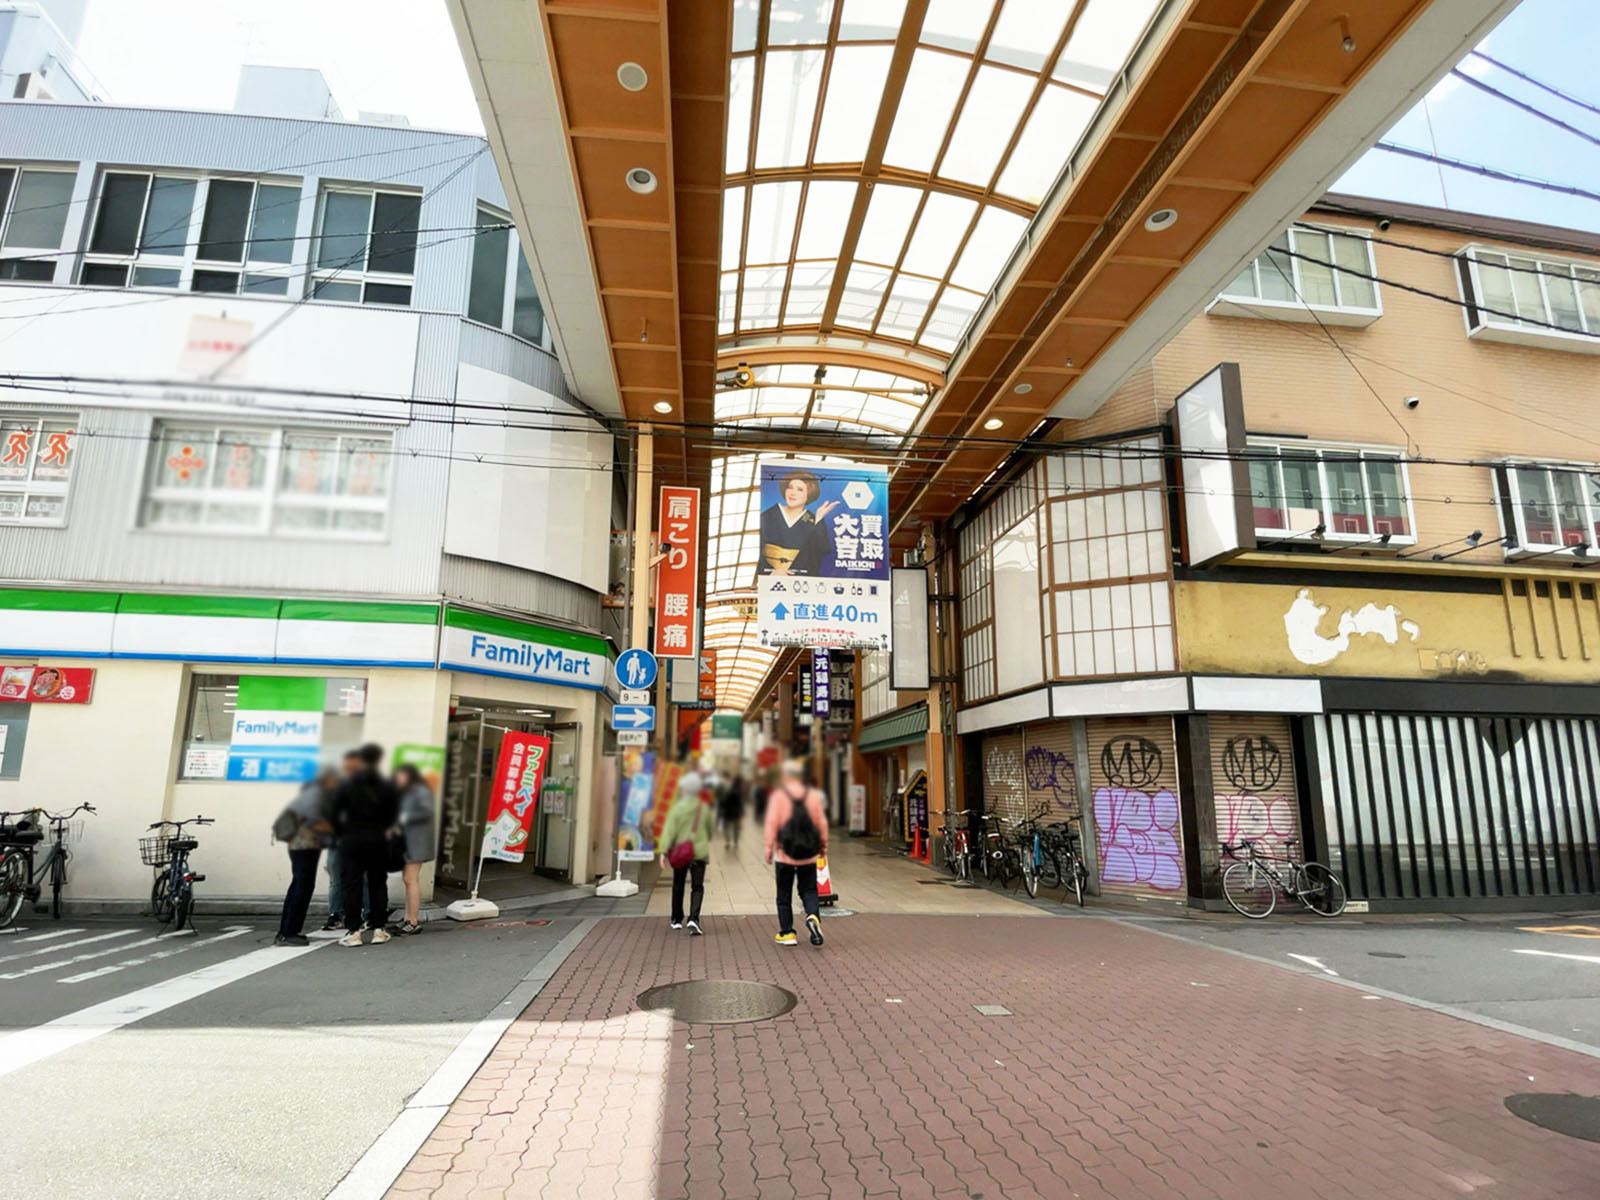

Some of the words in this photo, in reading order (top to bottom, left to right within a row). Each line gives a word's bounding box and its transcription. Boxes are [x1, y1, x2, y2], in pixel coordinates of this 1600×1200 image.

[667, 495, 693, 570] 肩こり
[833, 513, 860, 560] 大吉
[860, 514, 884, 560] 買取
[835, 559, 876, 569] DAIKICHI
[663, 593, 689, 648] 腰痛
[793, 602, 878, 623] 直進40m
[471, 635, 590, 676] FamilyMart
[235, 720, 318, 737] FamilyMart
[240, 758, 262, 778] 酒
[502, 742, 526, 804] 会員募集中
[513, 745, 545, 817] ファミペイ
